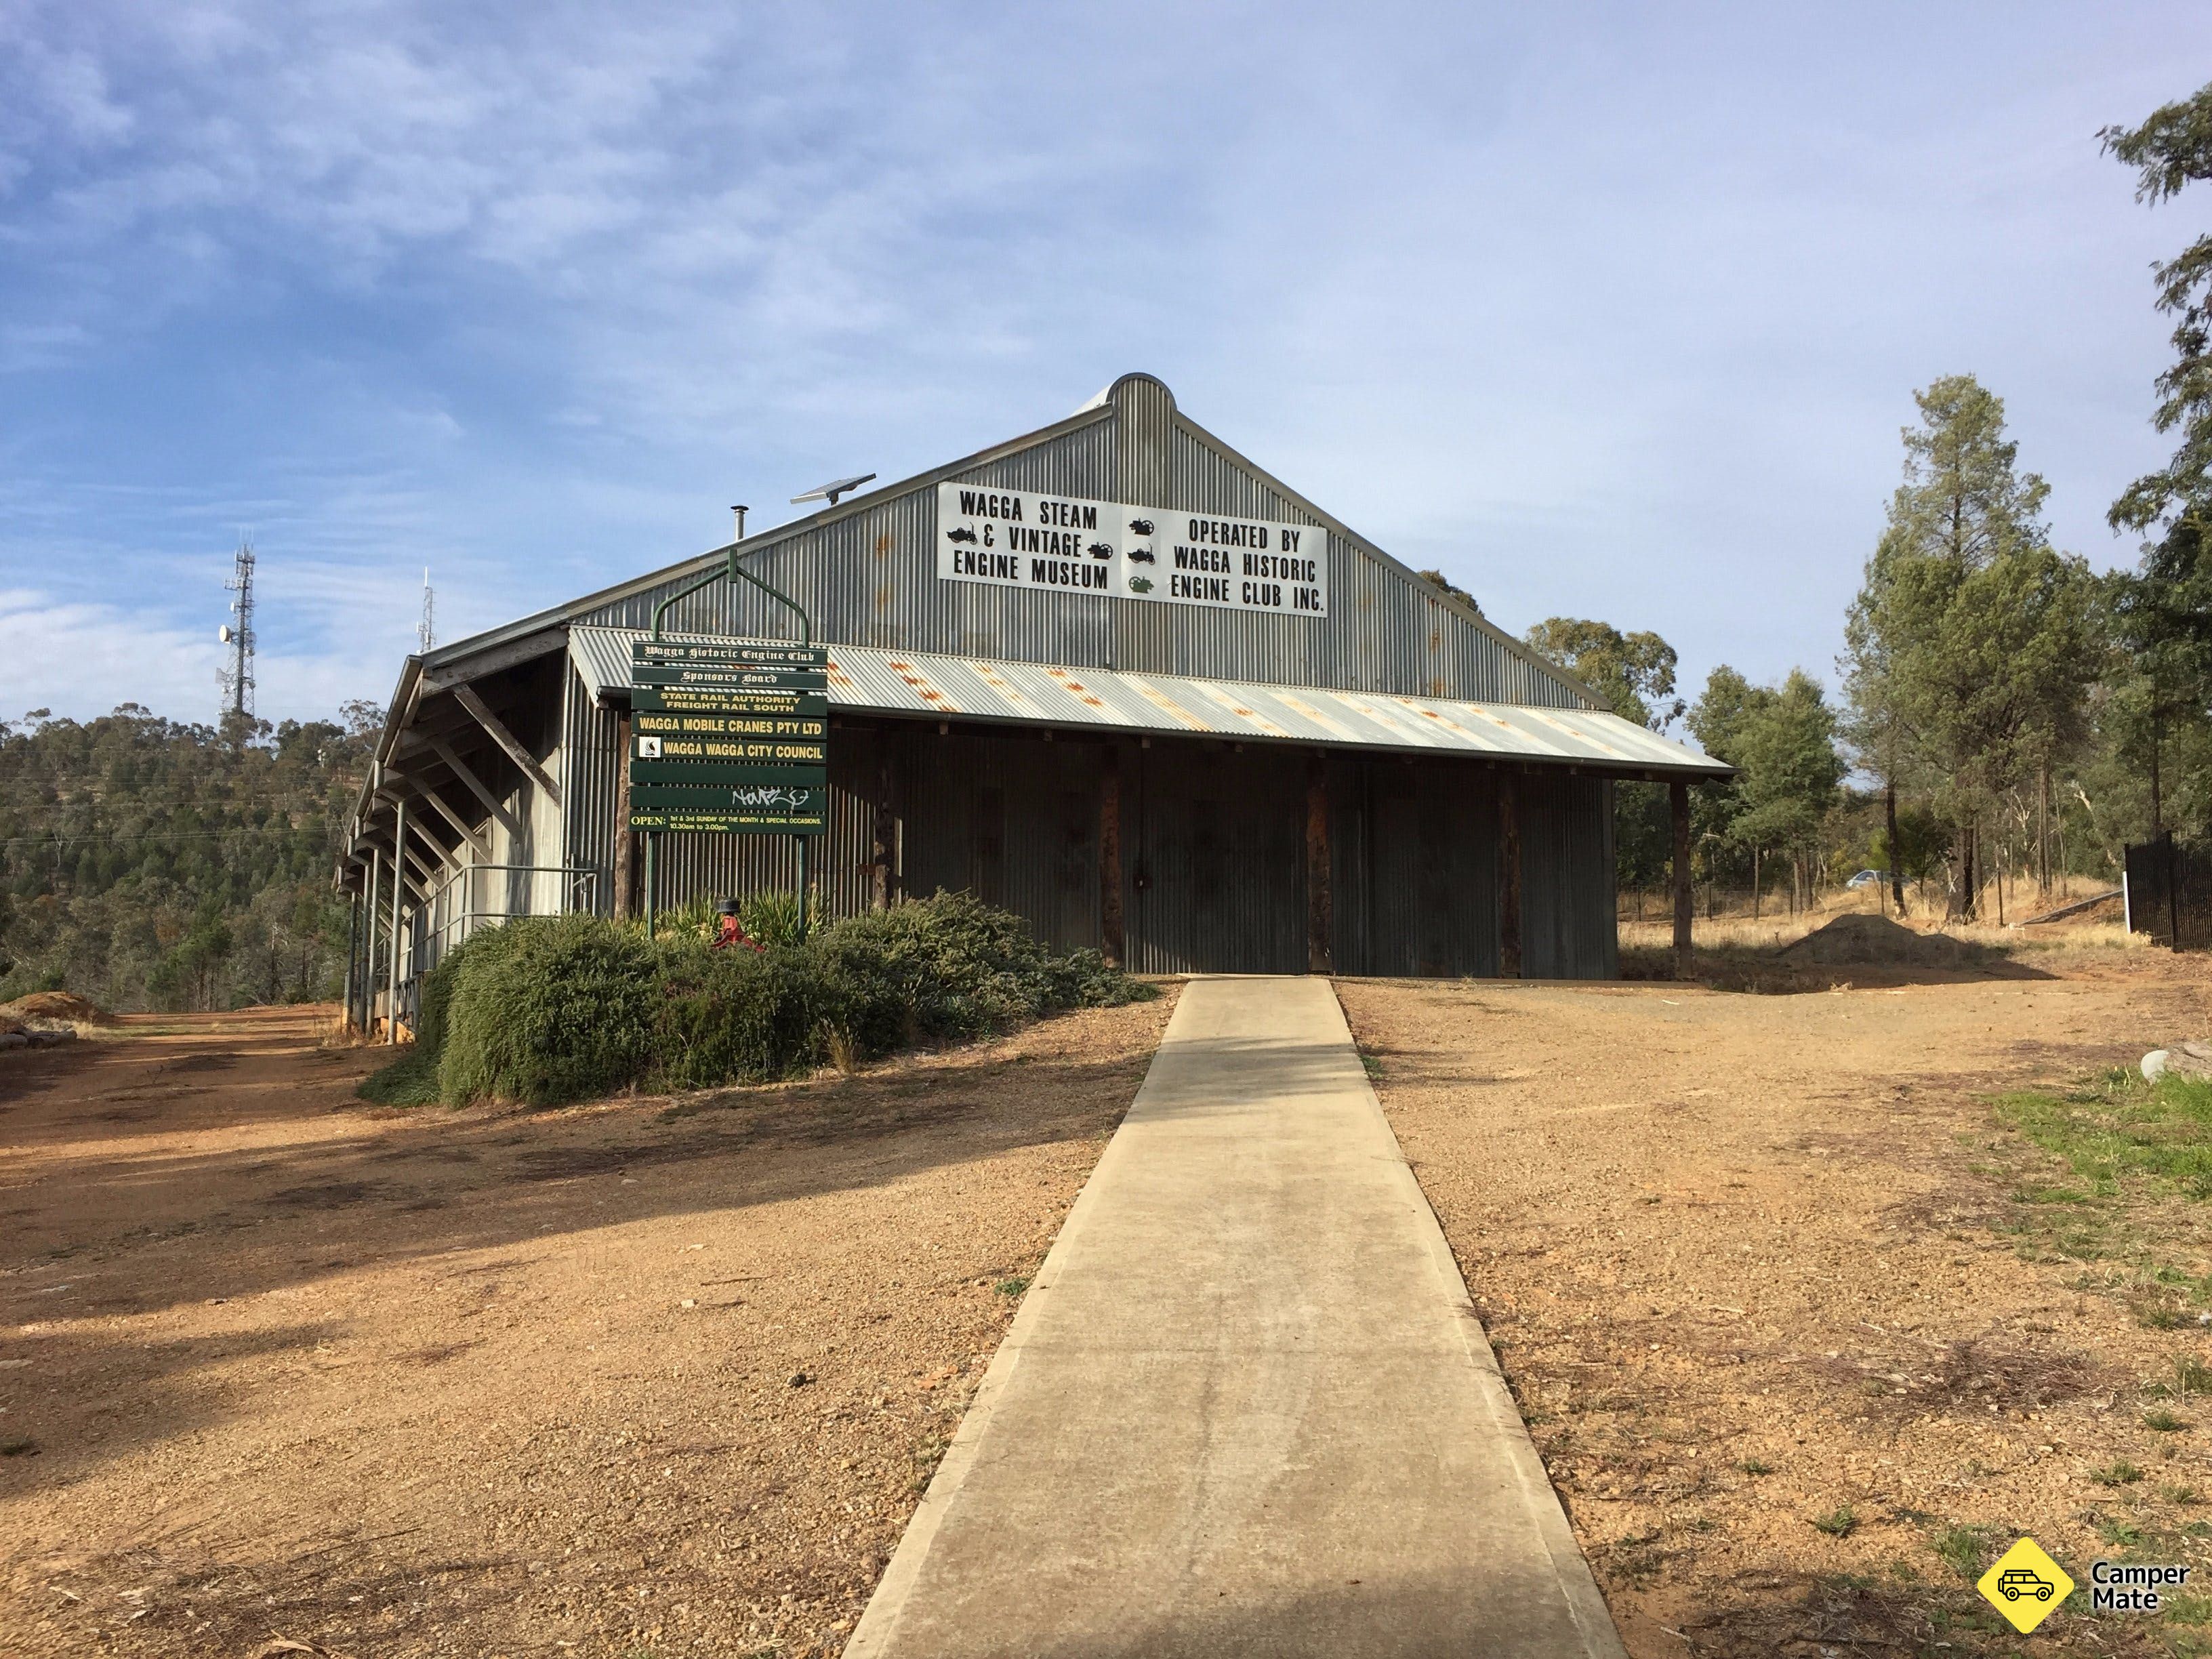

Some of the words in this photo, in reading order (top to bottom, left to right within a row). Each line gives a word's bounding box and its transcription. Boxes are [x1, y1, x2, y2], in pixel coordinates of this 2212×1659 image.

[960, 491, 1023, 521] WAGGA
[1040, 501, 1097, 530] STEAM
[984, 524, 994, 547] &
[1008, 527, 1082, 557] VINTAGE
[1189, 518, 1268, 549] OPERATED
[1282, 529, 1300, 552] BY
[954, 550, 1019, 579] ENGINE
[1031, 558, 1107, 590] MUSEUM
[1174, 546, 1231, 573] WAGGA
[1243, 553, 1315, 582] HISTORIC
[1171, 574, 1229, 602] ENGINE
[1242, 581, 1281, 607] CLUB
[1293, 587, 1324, 611] INC.
[644, 646, 684, 657] Wagga
[689, 648, 738, 659] Historic
[741, 650, 785, 661] Engine
[787, 652, 815, 661] Club
[680, 672, 737, 682] Sponsors
[741, 674, 778, 685] Board
[666, 701, 718, 710] FREIGHT
[732, 695, 800, 704] AUTHORITY
[639, 717, 680, 730] WAGGA
[683, 718, 724, 732] MOBILE
[728, 720, 773, 733] CRANES
[777, 722, 799, 734] PTY
[802, 723, 822, 735] LTD
[663, 741, 703, 755] WAGGA
[705, 743, 744, 756] WAGGA
[747, 745, 773, 757] CITY
[776, 745, 823, 759] COUNCIL
[631, 816, 666, 825] OPEN:
